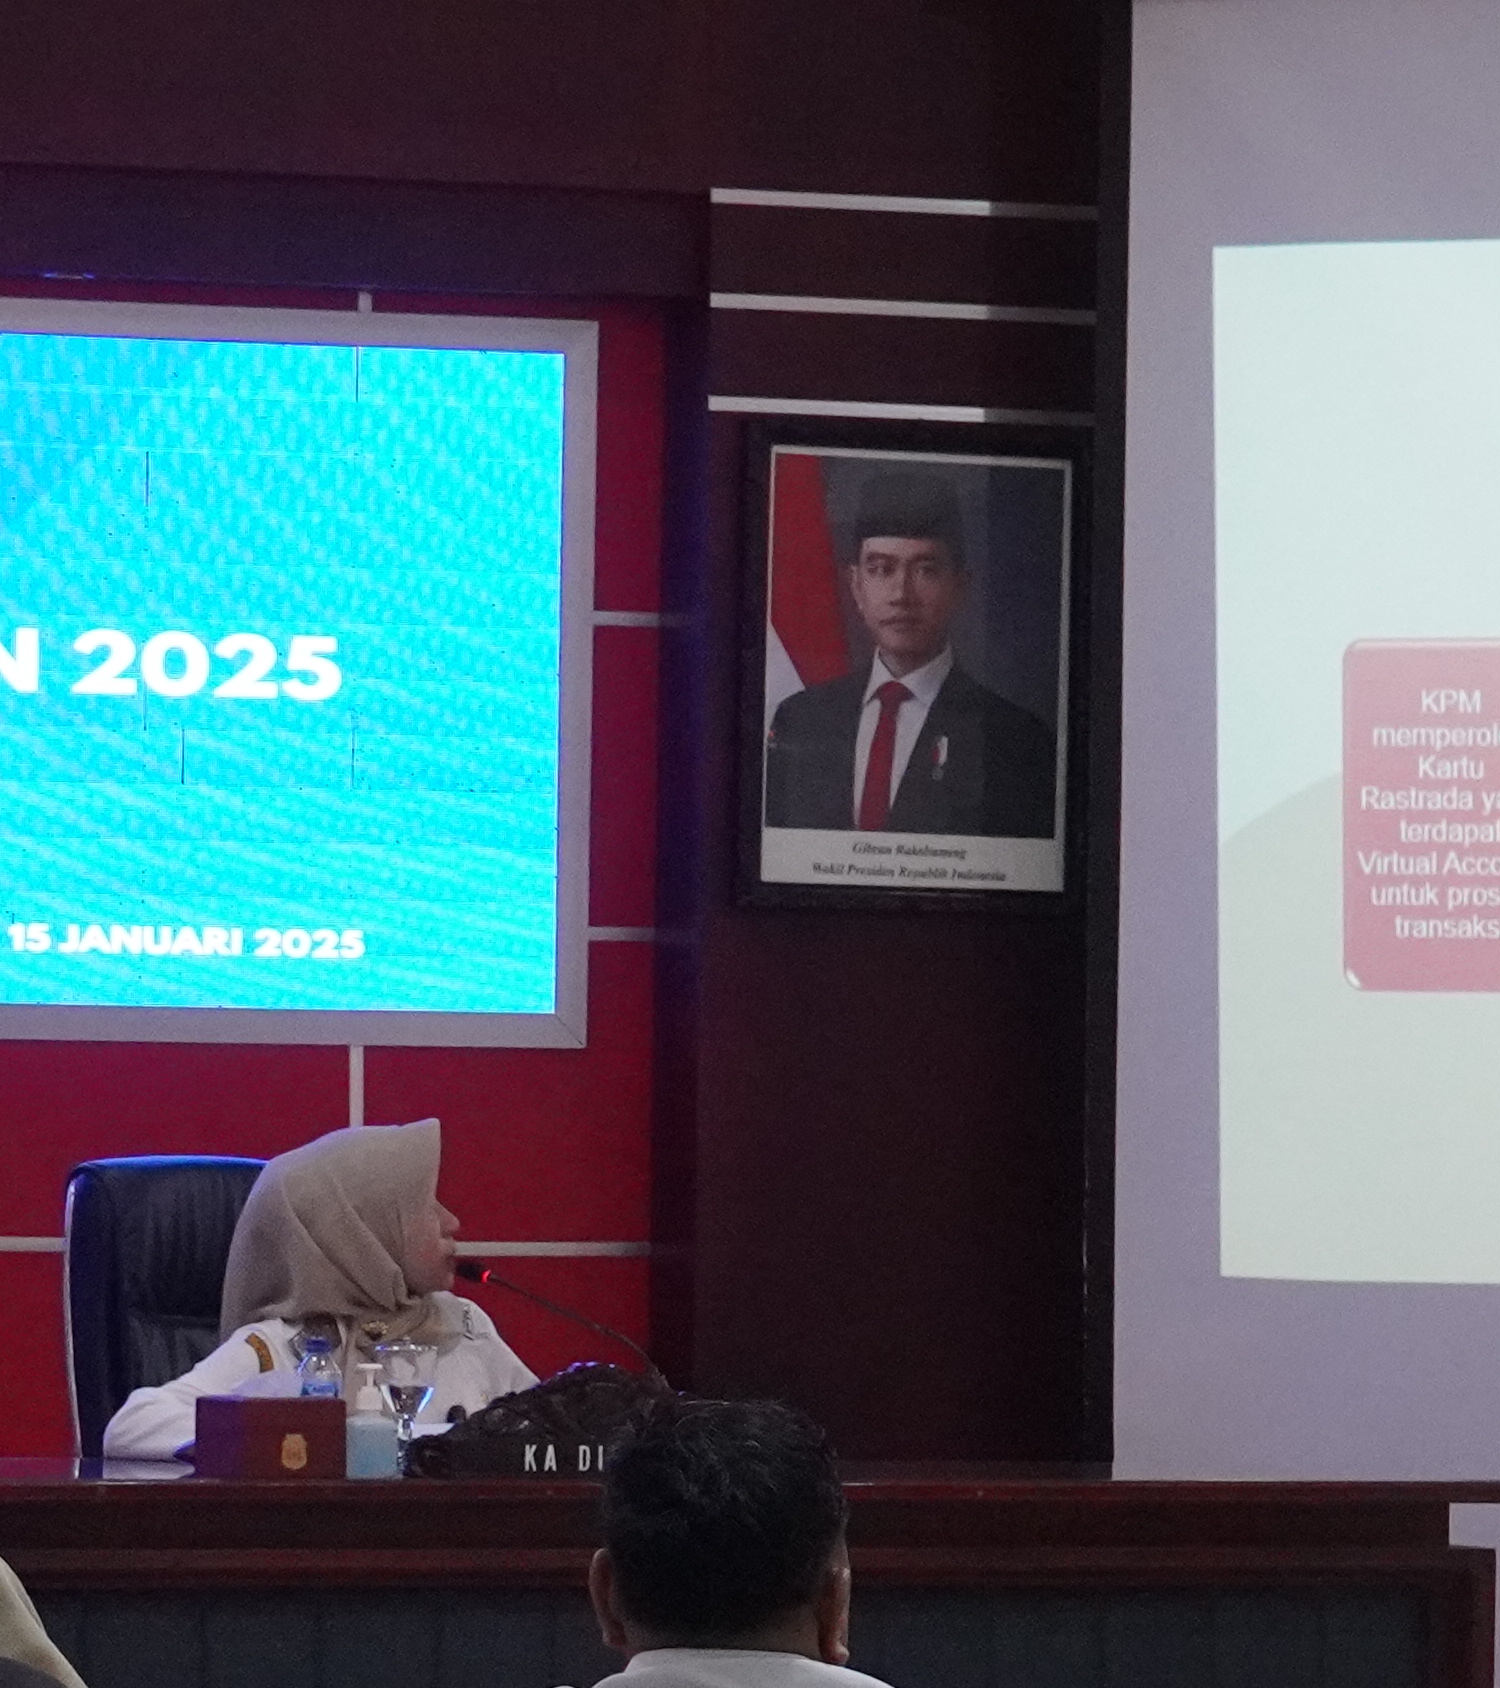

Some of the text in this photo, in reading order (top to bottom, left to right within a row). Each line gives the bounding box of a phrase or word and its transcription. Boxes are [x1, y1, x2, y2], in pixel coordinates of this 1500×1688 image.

[71, 627, 341, 702] 2025
[1421, 690, 1481, 714] KPM
[1418, 756, 1484, 779] Kartu
[1361, 788, 1473, 811] Rastrada
[1358, 851, 1437, 875] Virtual
[1371, 884, 1439, 906] untuk
[8, 921, 51, 955] 15
[59, 922, 242, 957] JANUARI
[253, 926, 365, 959] 2025
[525, 1444, 557, 1472] KA
